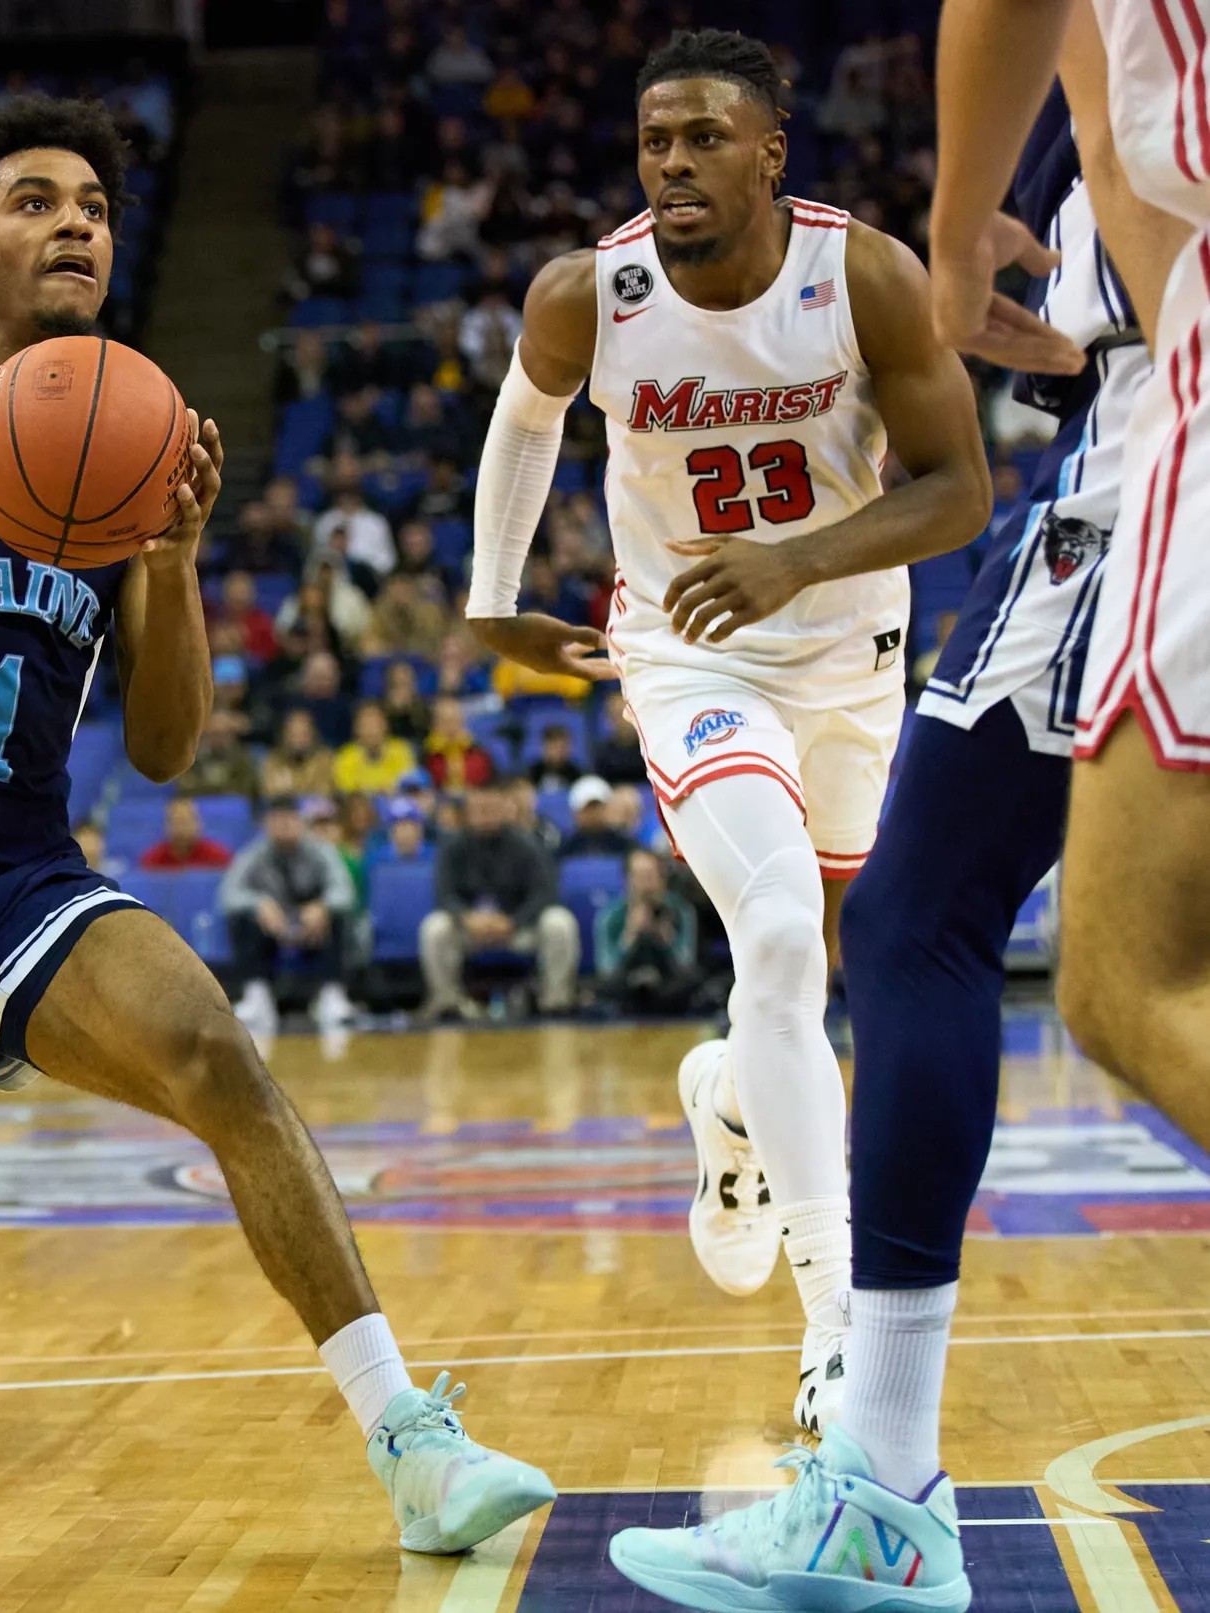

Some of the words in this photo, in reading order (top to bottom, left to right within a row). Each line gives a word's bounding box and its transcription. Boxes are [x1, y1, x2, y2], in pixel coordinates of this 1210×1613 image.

[618, 267, 643, 281] UNITED
[625, 277, 639, 288] FOR
[621, 283, 647, 298] JUSTICE
[627, 370, 848, 432] MARIST
[685, 439, 816, 534] 23
[886, 635, 895, 648] L
[683, 710, 749, 757] MAAC
